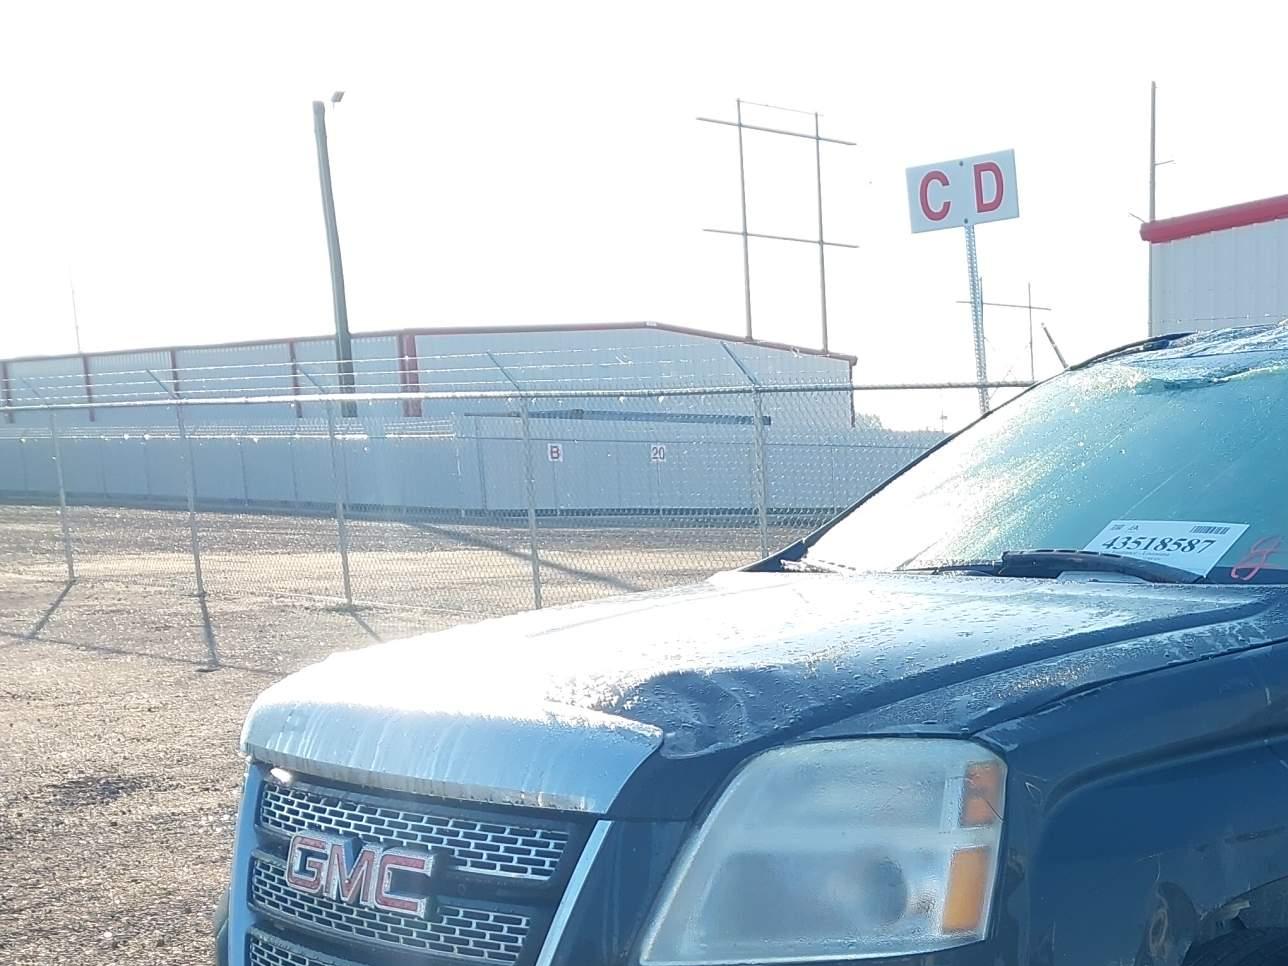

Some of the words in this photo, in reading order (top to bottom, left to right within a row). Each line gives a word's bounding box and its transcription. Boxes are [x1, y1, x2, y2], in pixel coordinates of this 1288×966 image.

[920, 170, 951, 221] C
[973, 161, 1004, 213] D
[550, 445, 560, 460] B
[651, 446, 665, 460] 20
[1101, 535, 1217, 553] 43518587
[286, 831, 434, 918] GMC
